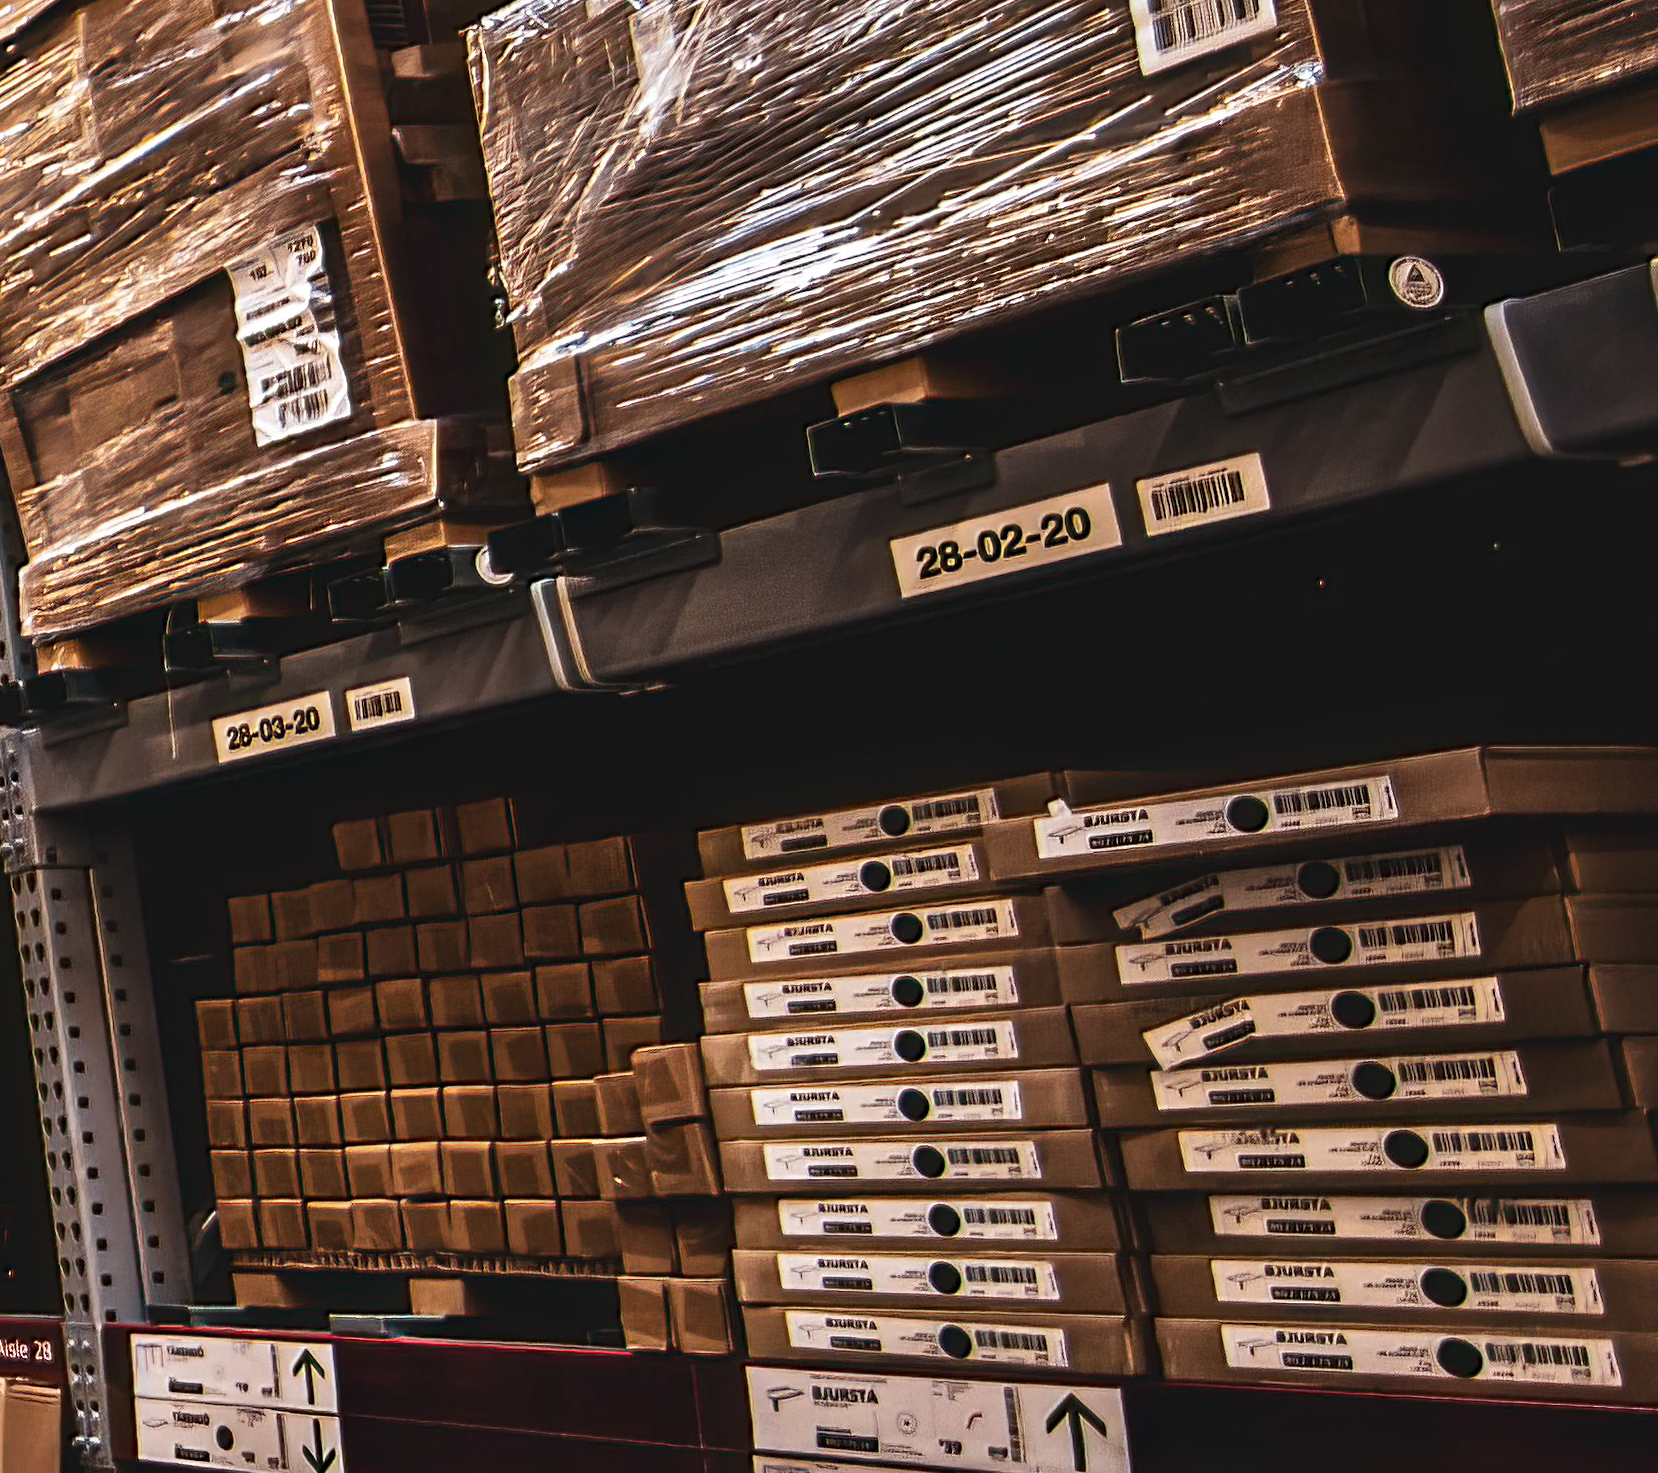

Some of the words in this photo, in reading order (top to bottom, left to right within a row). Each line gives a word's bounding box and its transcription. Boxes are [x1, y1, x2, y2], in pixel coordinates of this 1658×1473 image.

[915, 506, 1092, 579] 28-02-20
[226, 706, 320, 751] 28-03-20
[1084, 809, 1148, 827] BJURSTA
[1260, 1198, 1331, 1212] BJURSTA
[1264, 1264, 1335, 1278] BJURSTA
[1275, 1330, 1347, 1345] BJURSTA
[34, 1340, 52, 1362] 28
[812, 1386, 878, 1404] BJURSTA
